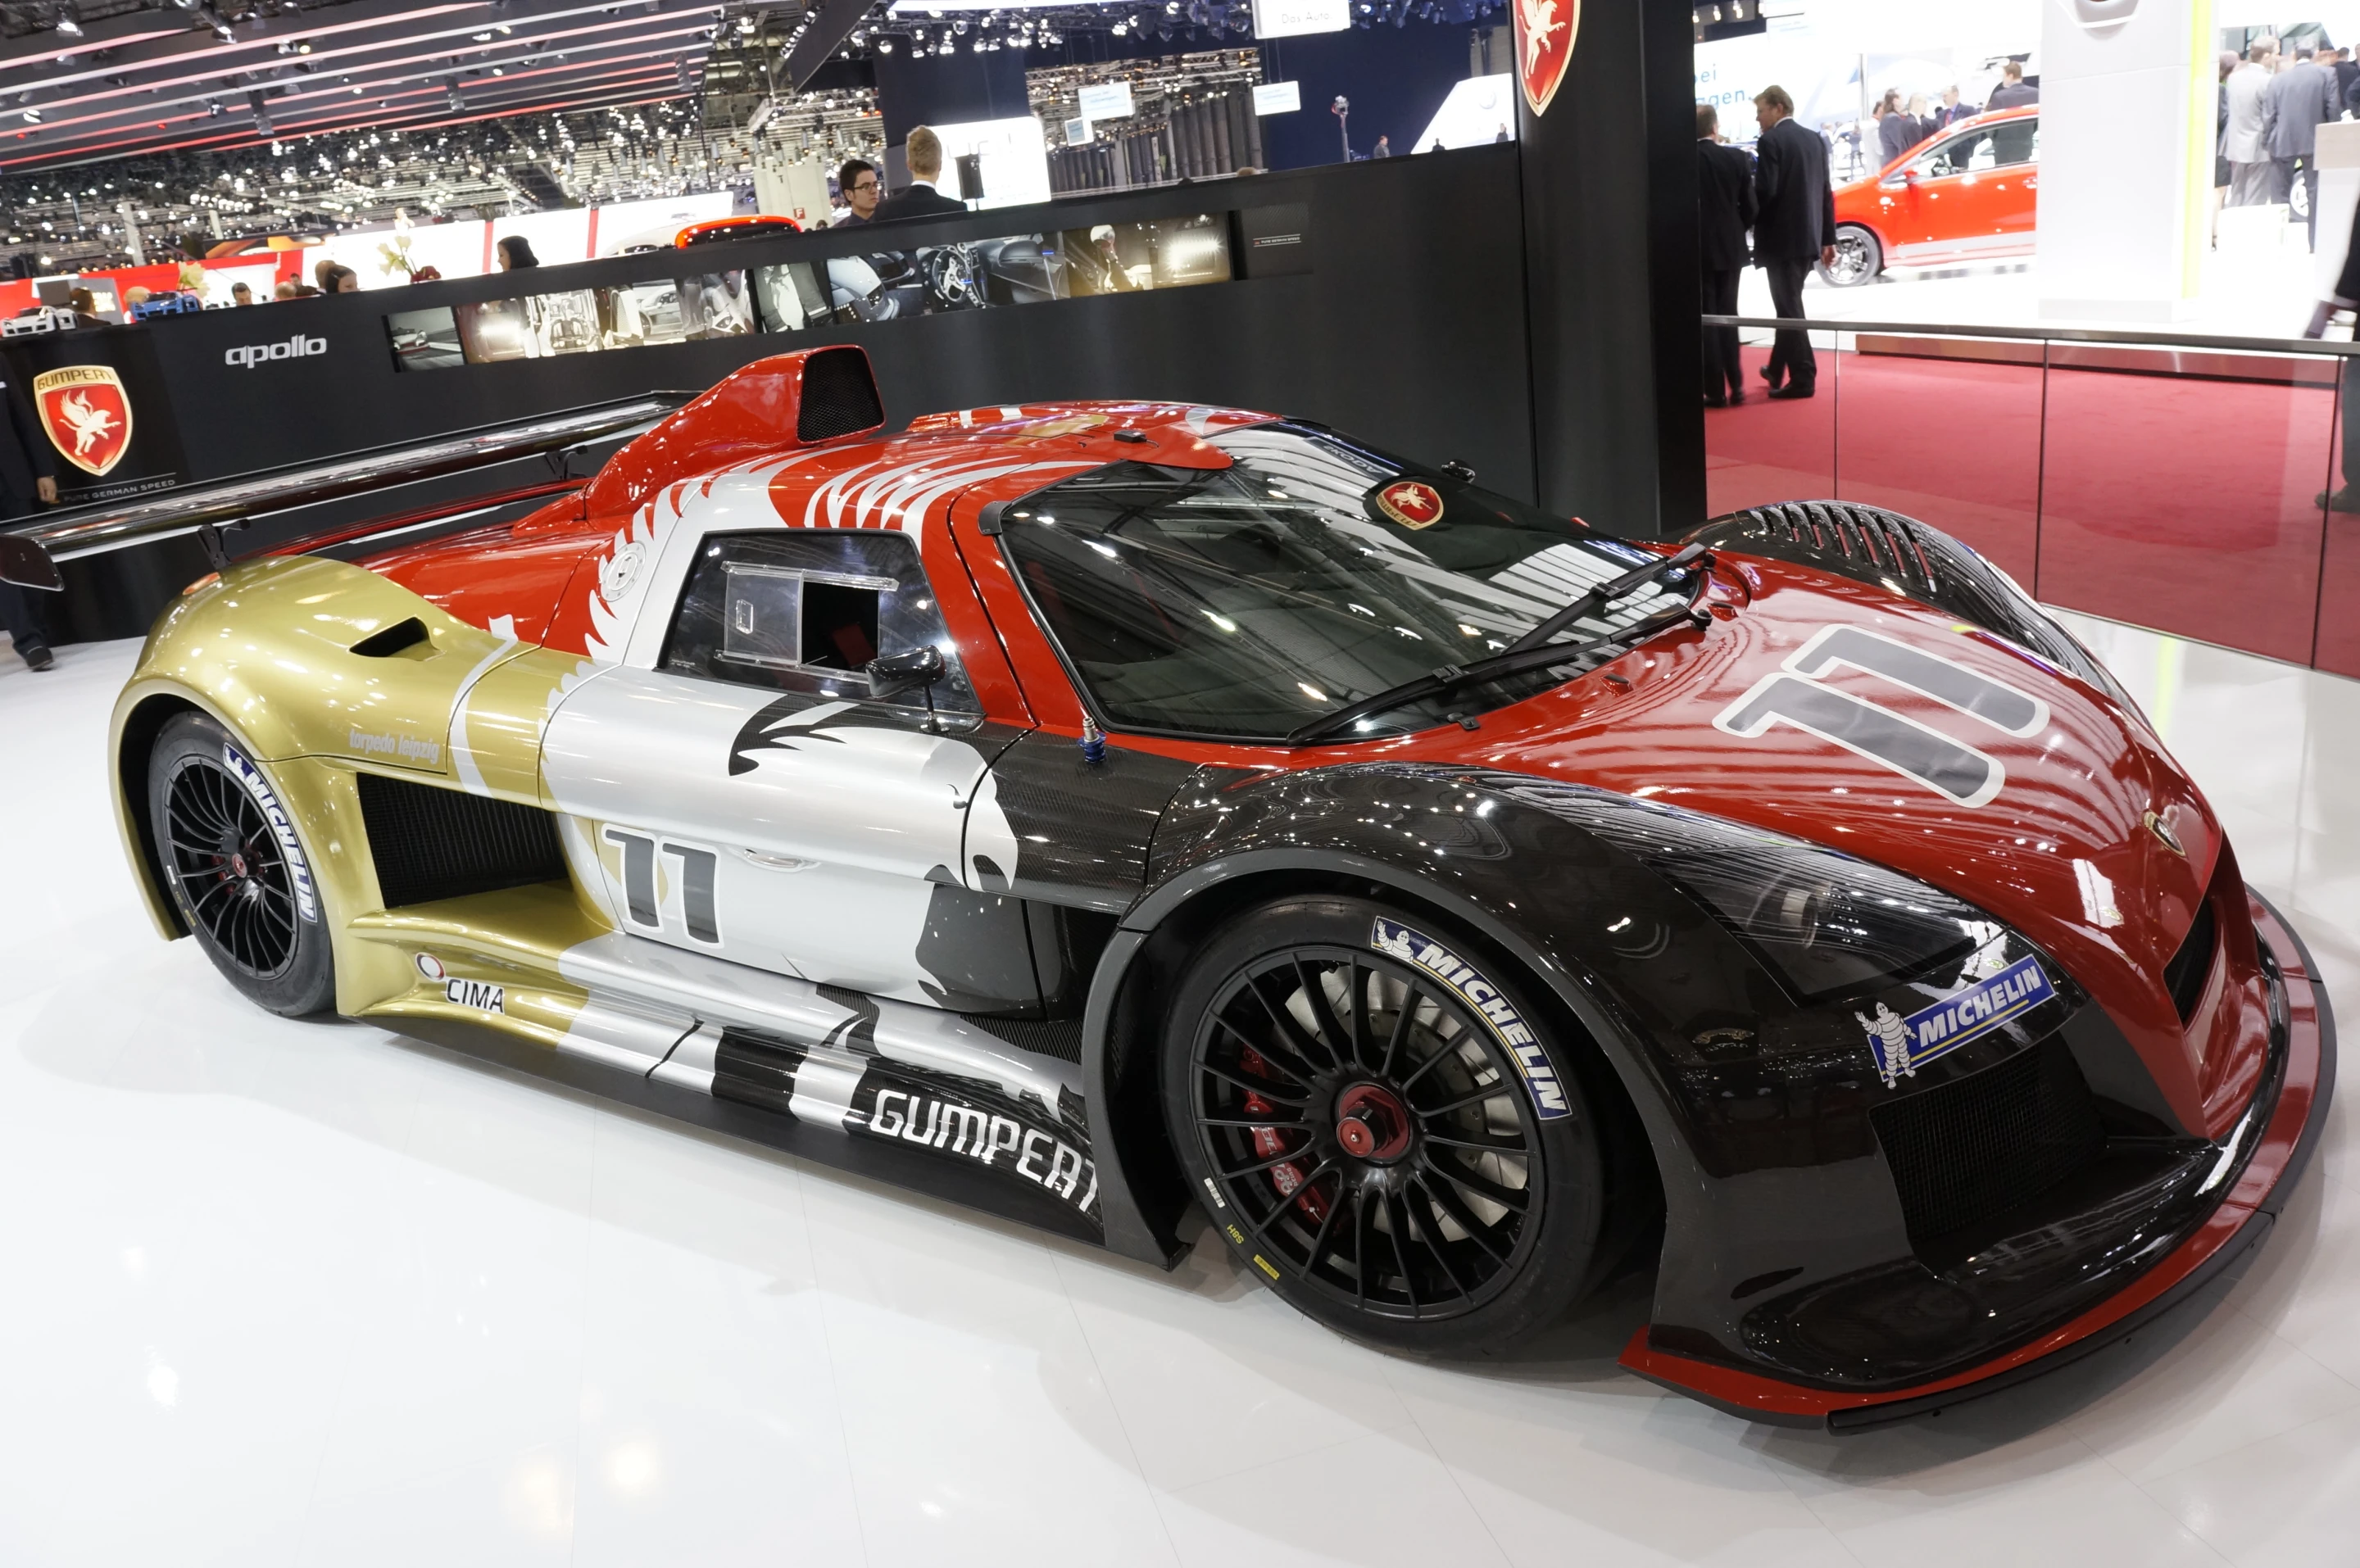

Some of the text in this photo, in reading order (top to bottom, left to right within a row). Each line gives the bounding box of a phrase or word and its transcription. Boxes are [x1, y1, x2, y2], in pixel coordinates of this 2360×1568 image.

[1281, 13, 1301, 24] Das
[1695, 63, 1717, 83] ei
[225, 333, 327, 369] apollo
[37, 369, 114, 391] GUMPERT
[92, 486, 138, 499] GERMAN
[141, 478, 176, 492] SPEED
[349, 728, 440, 765] torpedo leipzig
[246, 771, 315, 918] MICHELIN
[601, 823, 724, 949] 11
[447, 978, 504, 1013] CIMA
[1918, 965, 2042, 1048] MICHELIN
[1416, 943, 1567, 1111] MICHELIN
